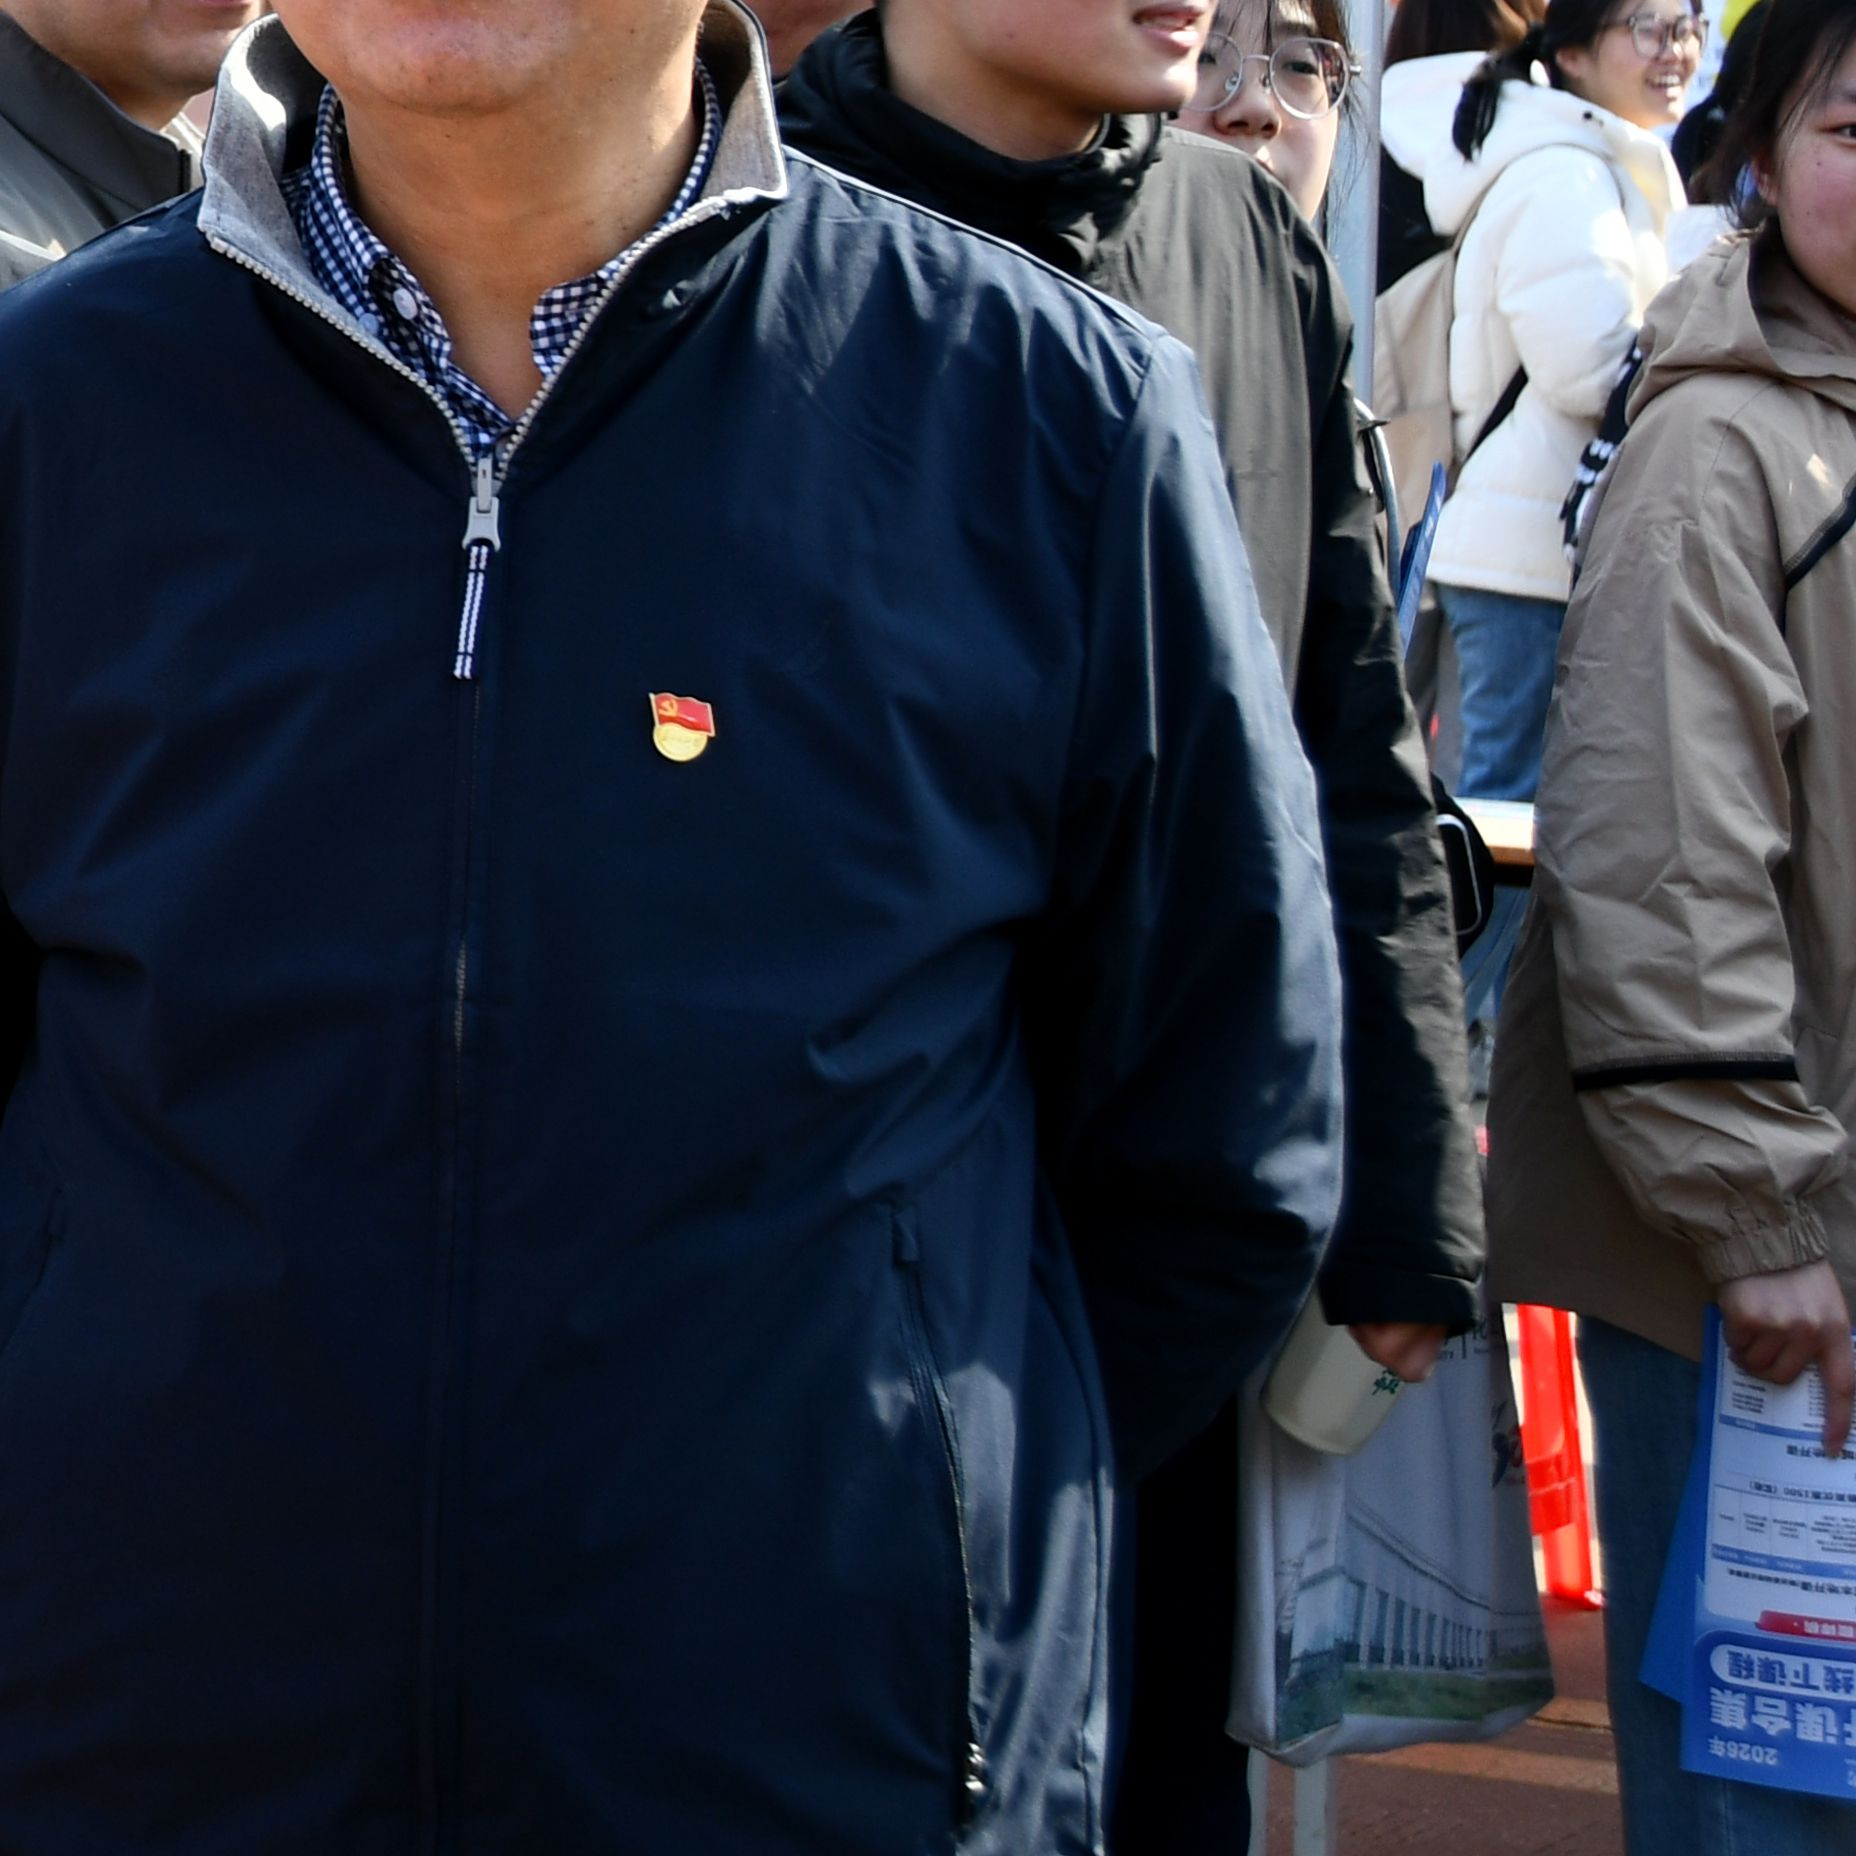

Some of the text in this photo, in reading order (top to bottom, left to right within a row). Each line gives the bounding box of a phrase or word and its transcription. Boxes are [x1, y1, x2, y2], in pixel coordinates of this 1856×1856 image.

[1726, 1650, 1854, 1696] 线下课程
[1707, 1735, 1779, 1766] 2026年
